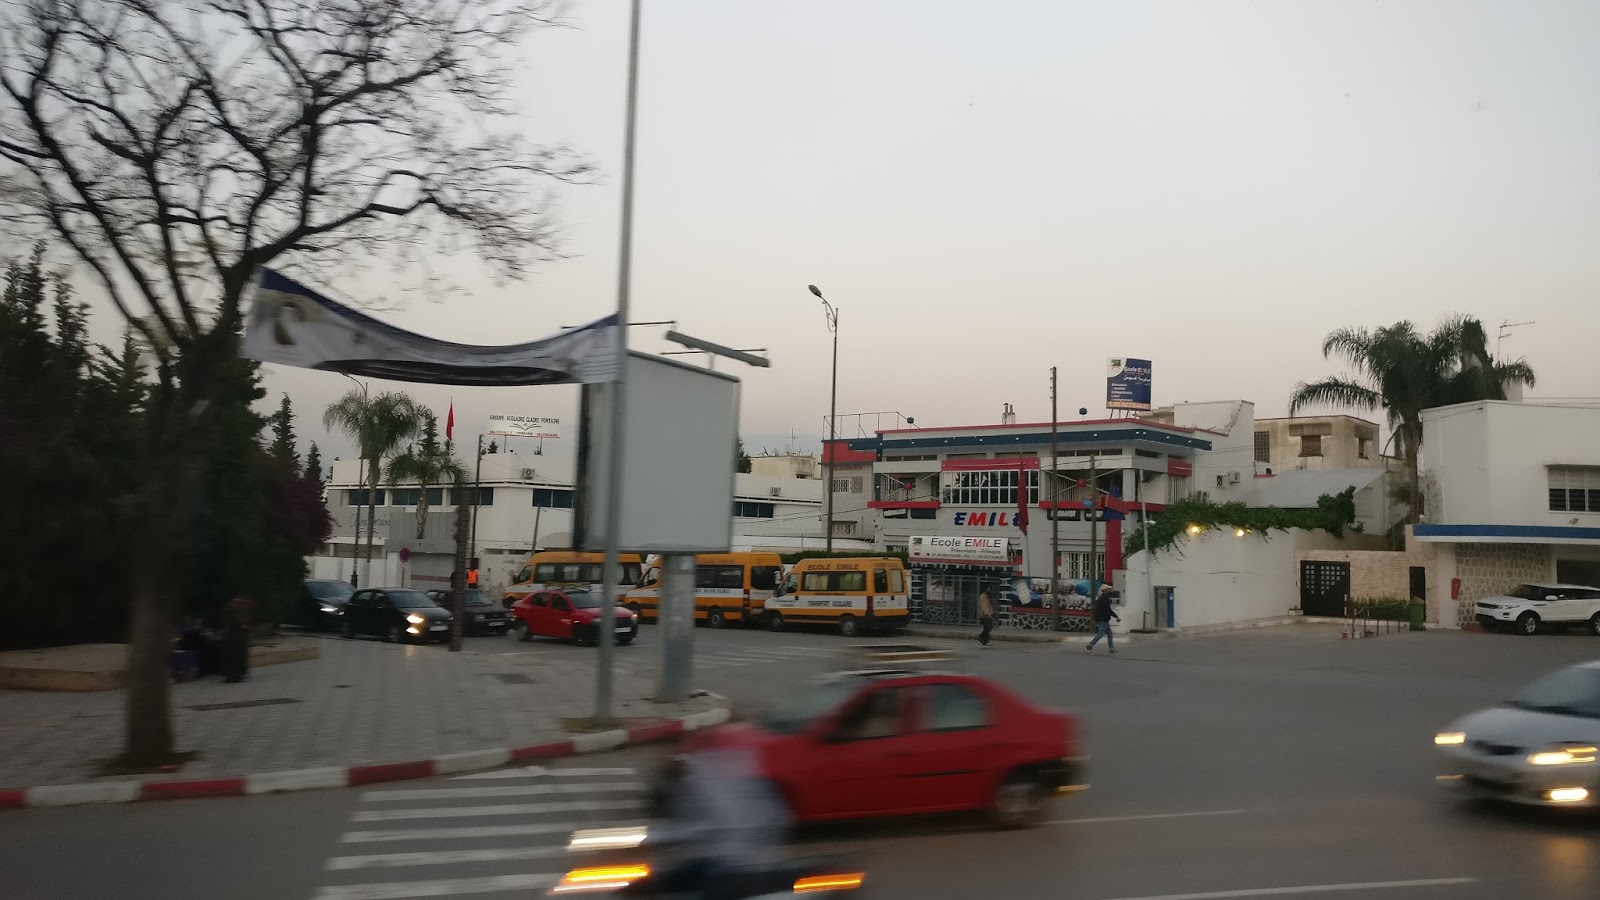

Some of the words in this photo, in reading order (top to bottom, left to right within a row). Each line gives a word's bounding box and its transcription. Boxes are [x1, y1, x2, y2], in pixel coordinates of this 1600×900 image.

[930, 537, 960, 547] Ecole
[965, 538, 1001, 548] EMILE
[808, 563, 831, 571] ECOLE
